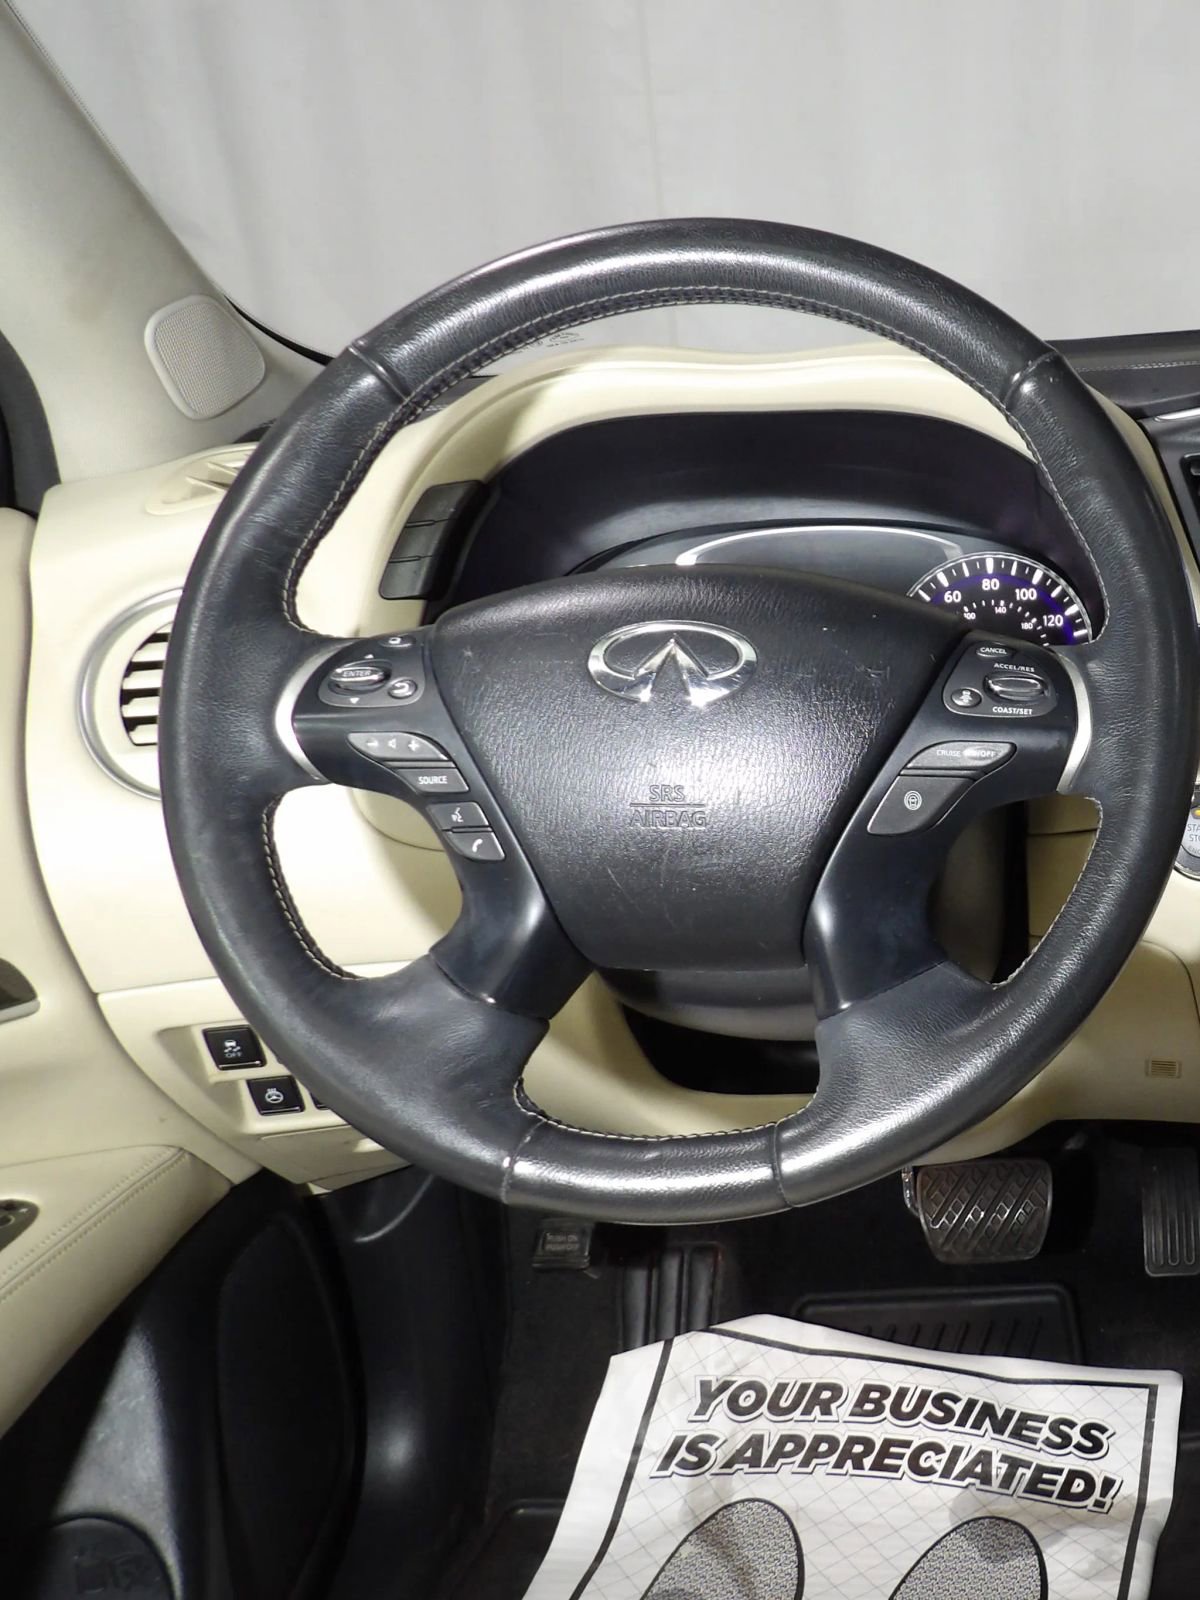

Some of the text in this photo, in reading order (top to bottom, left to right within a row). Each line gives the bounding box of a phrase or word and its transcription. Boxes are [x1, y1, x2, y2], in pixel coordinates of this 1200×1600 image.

[981, 578, 1000, 591] 80
[943, 590, 962, 603] 60
[1015, 588, 1037, 601] 100
[995, 606, 1007, 614] 140
[1021, 622, 1034, 630] 180
[1043, 615, 1064, 627] 120
[980, 646, 1007, 654] CANCEL
[994, 662, 1035, 672] ACCEL/RES
[992, 706, 1033, 715] COAST/SET
[418, 775, 448, 784] SOURCE
[649, 784, 686, 802] SRS
[630, 810, 707, 828] AIRBAG
[689, 1377, 1114, 1457] YOUR BUSINESS
[652, 1433, 1122, 1511] IS APPRECIATED!
